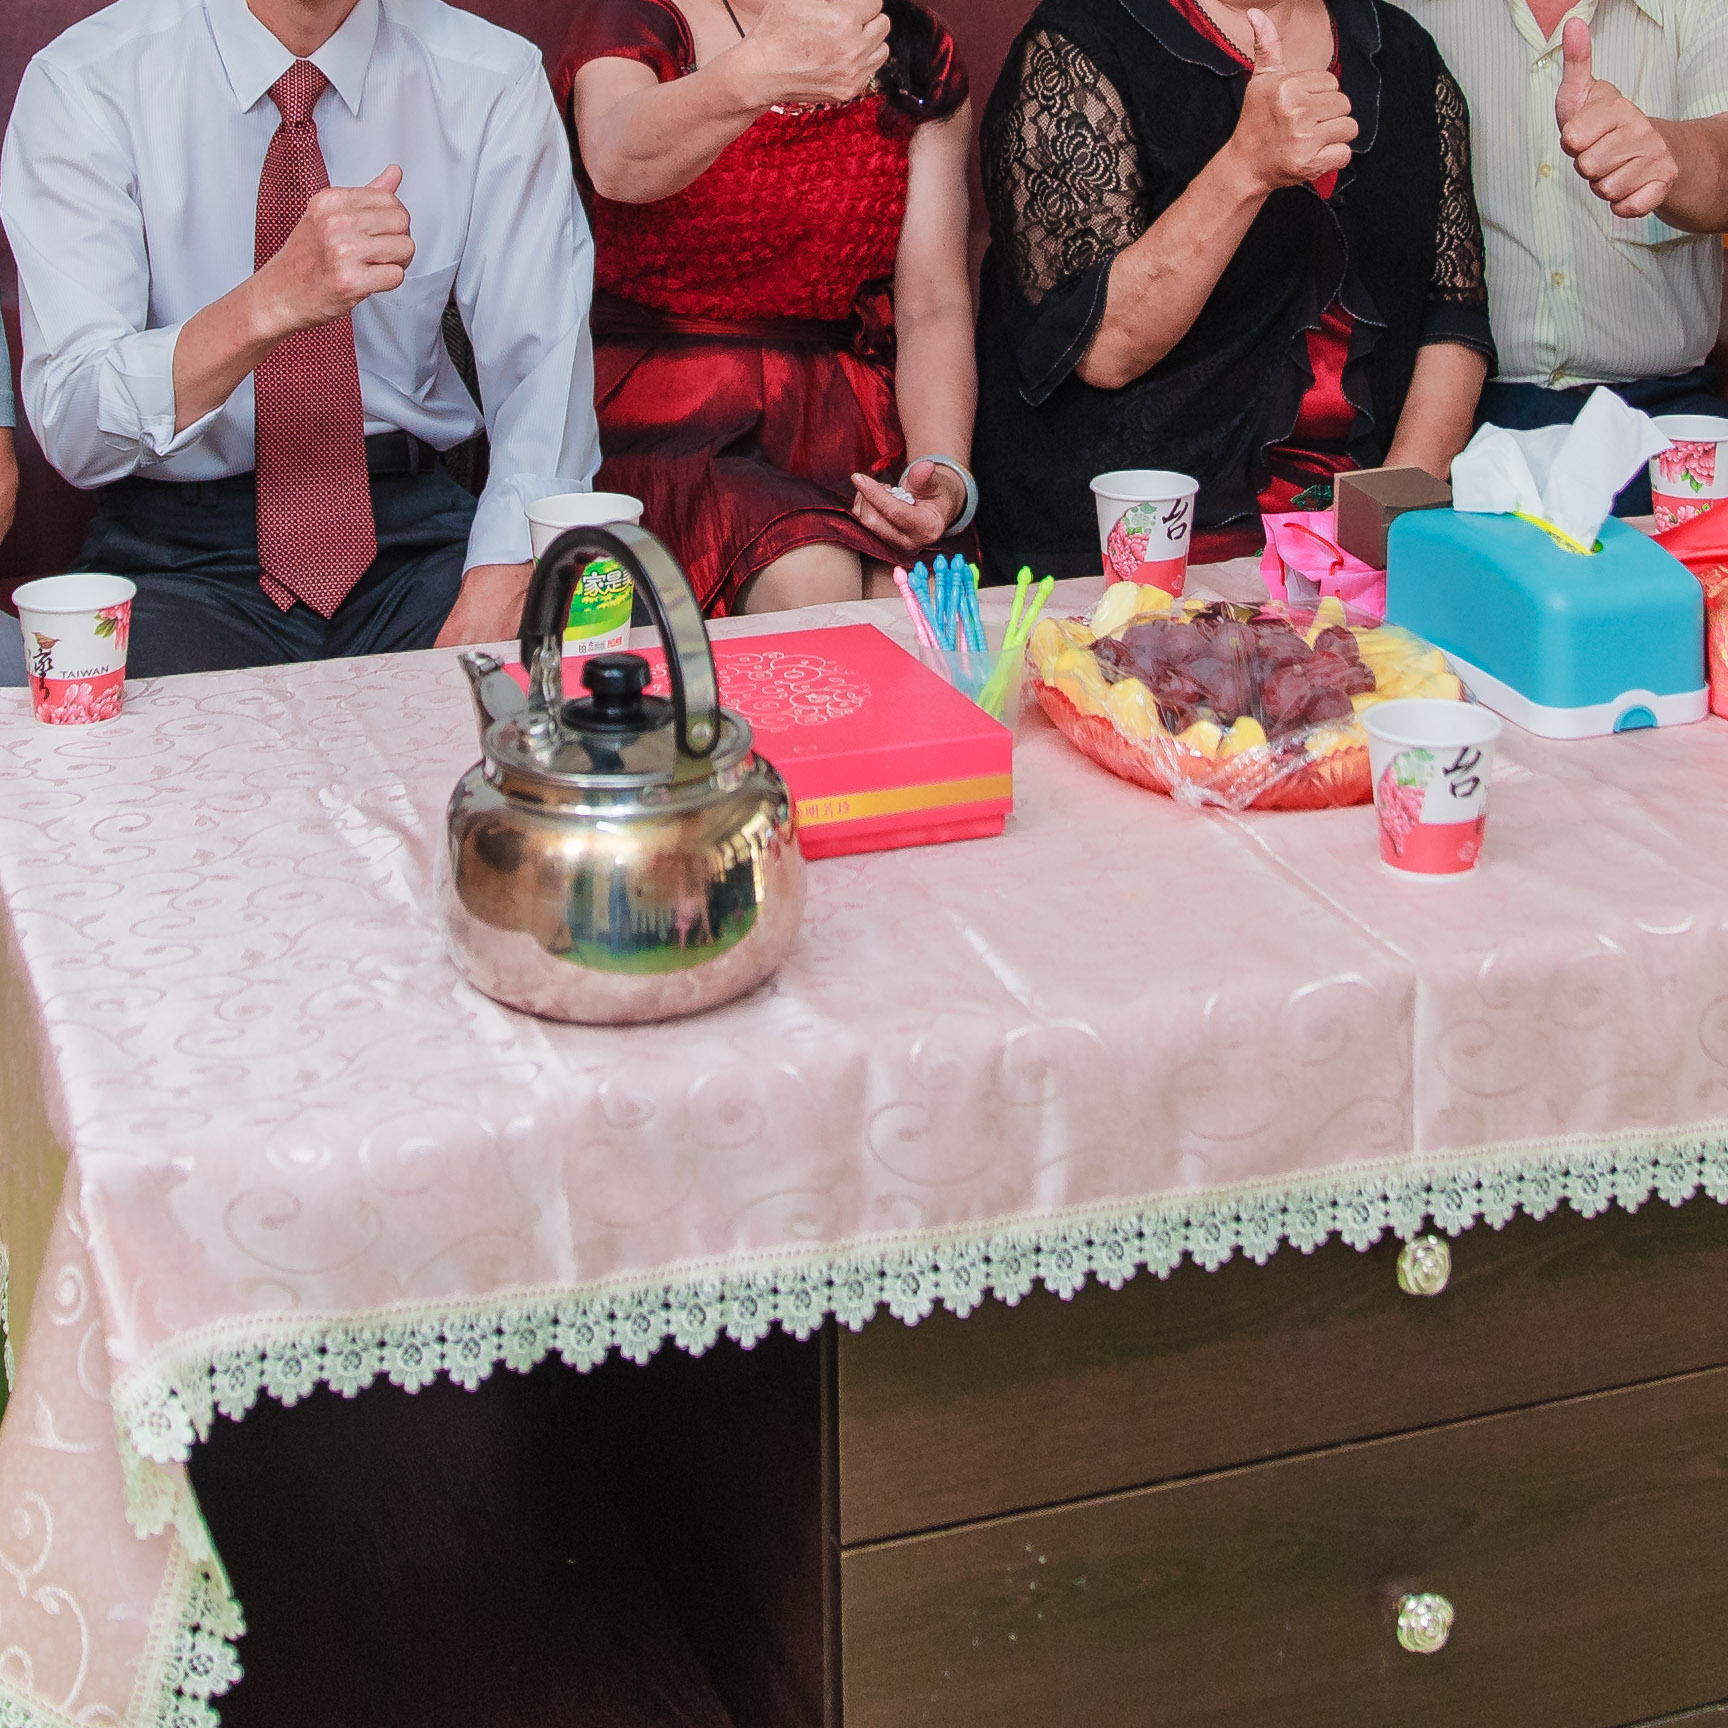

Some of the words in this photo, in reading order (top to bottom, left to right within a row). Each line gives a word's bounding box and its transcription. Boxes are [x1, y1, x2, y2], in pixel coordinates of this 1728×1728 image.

[1162, 498, 1189, 541] 台
[60, 665, 109, 679] TAIWAN
[1442, 746, 1481, 799] 台
